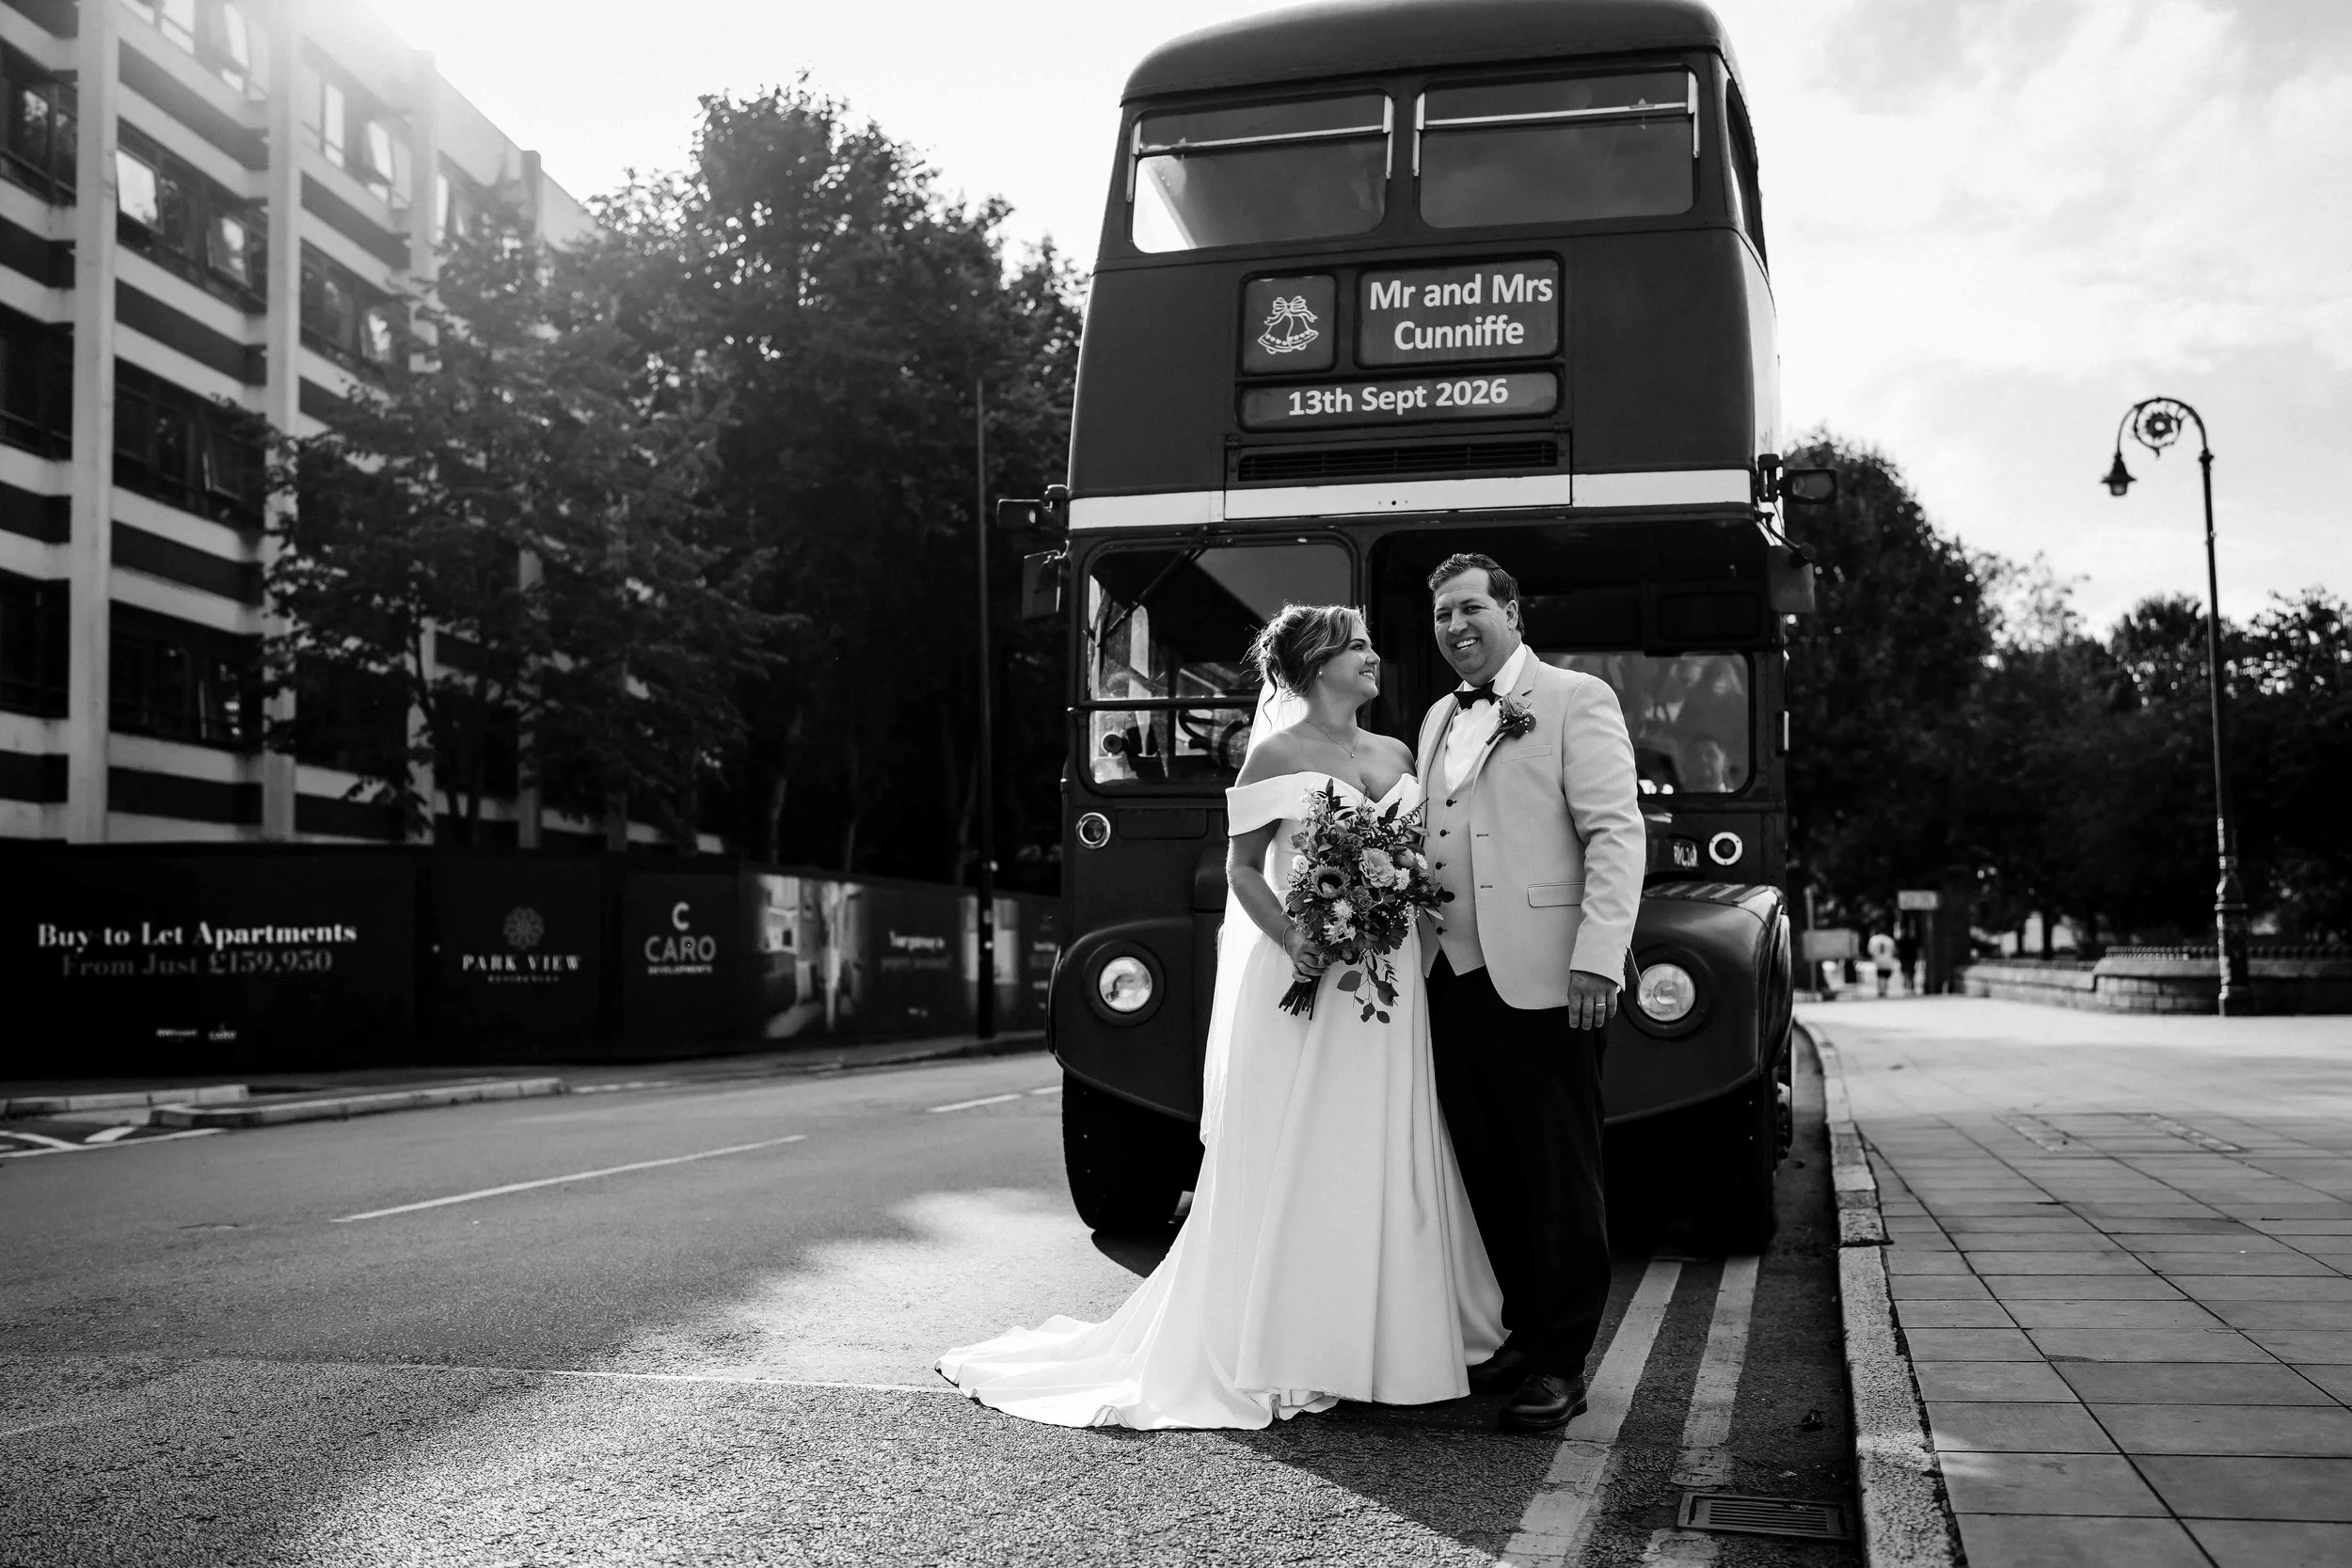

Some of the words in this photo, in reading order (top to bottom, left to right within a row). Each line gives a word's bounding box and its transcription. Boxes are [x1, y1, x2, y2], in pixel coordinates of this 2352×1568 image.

[1370, 279, 1417, 310] Mr
[1422, 274, 1482, 307] and
[1492, 273, 1552, 304] Mrs
[1393, 314, 1525, 351] Cunniffe
[1288, 388, 1353, 416] 13th
[1361, 385, 1427, 415] Sept
[1436, 377, 1509, 406] 2026
[39, 924, 90, 953] Buy
[104, 927, 131, 946] to
[142, 922, 183, 945] Let
[196, 921, 358, 951] Apartments
[644, 935, 717, 962] CARO
[63, 954, 134, 976] From
[142, 953, 198, 975] Just
[462, 954, 517, 972] PARK
[527, 954, 582, 972] VIEW
